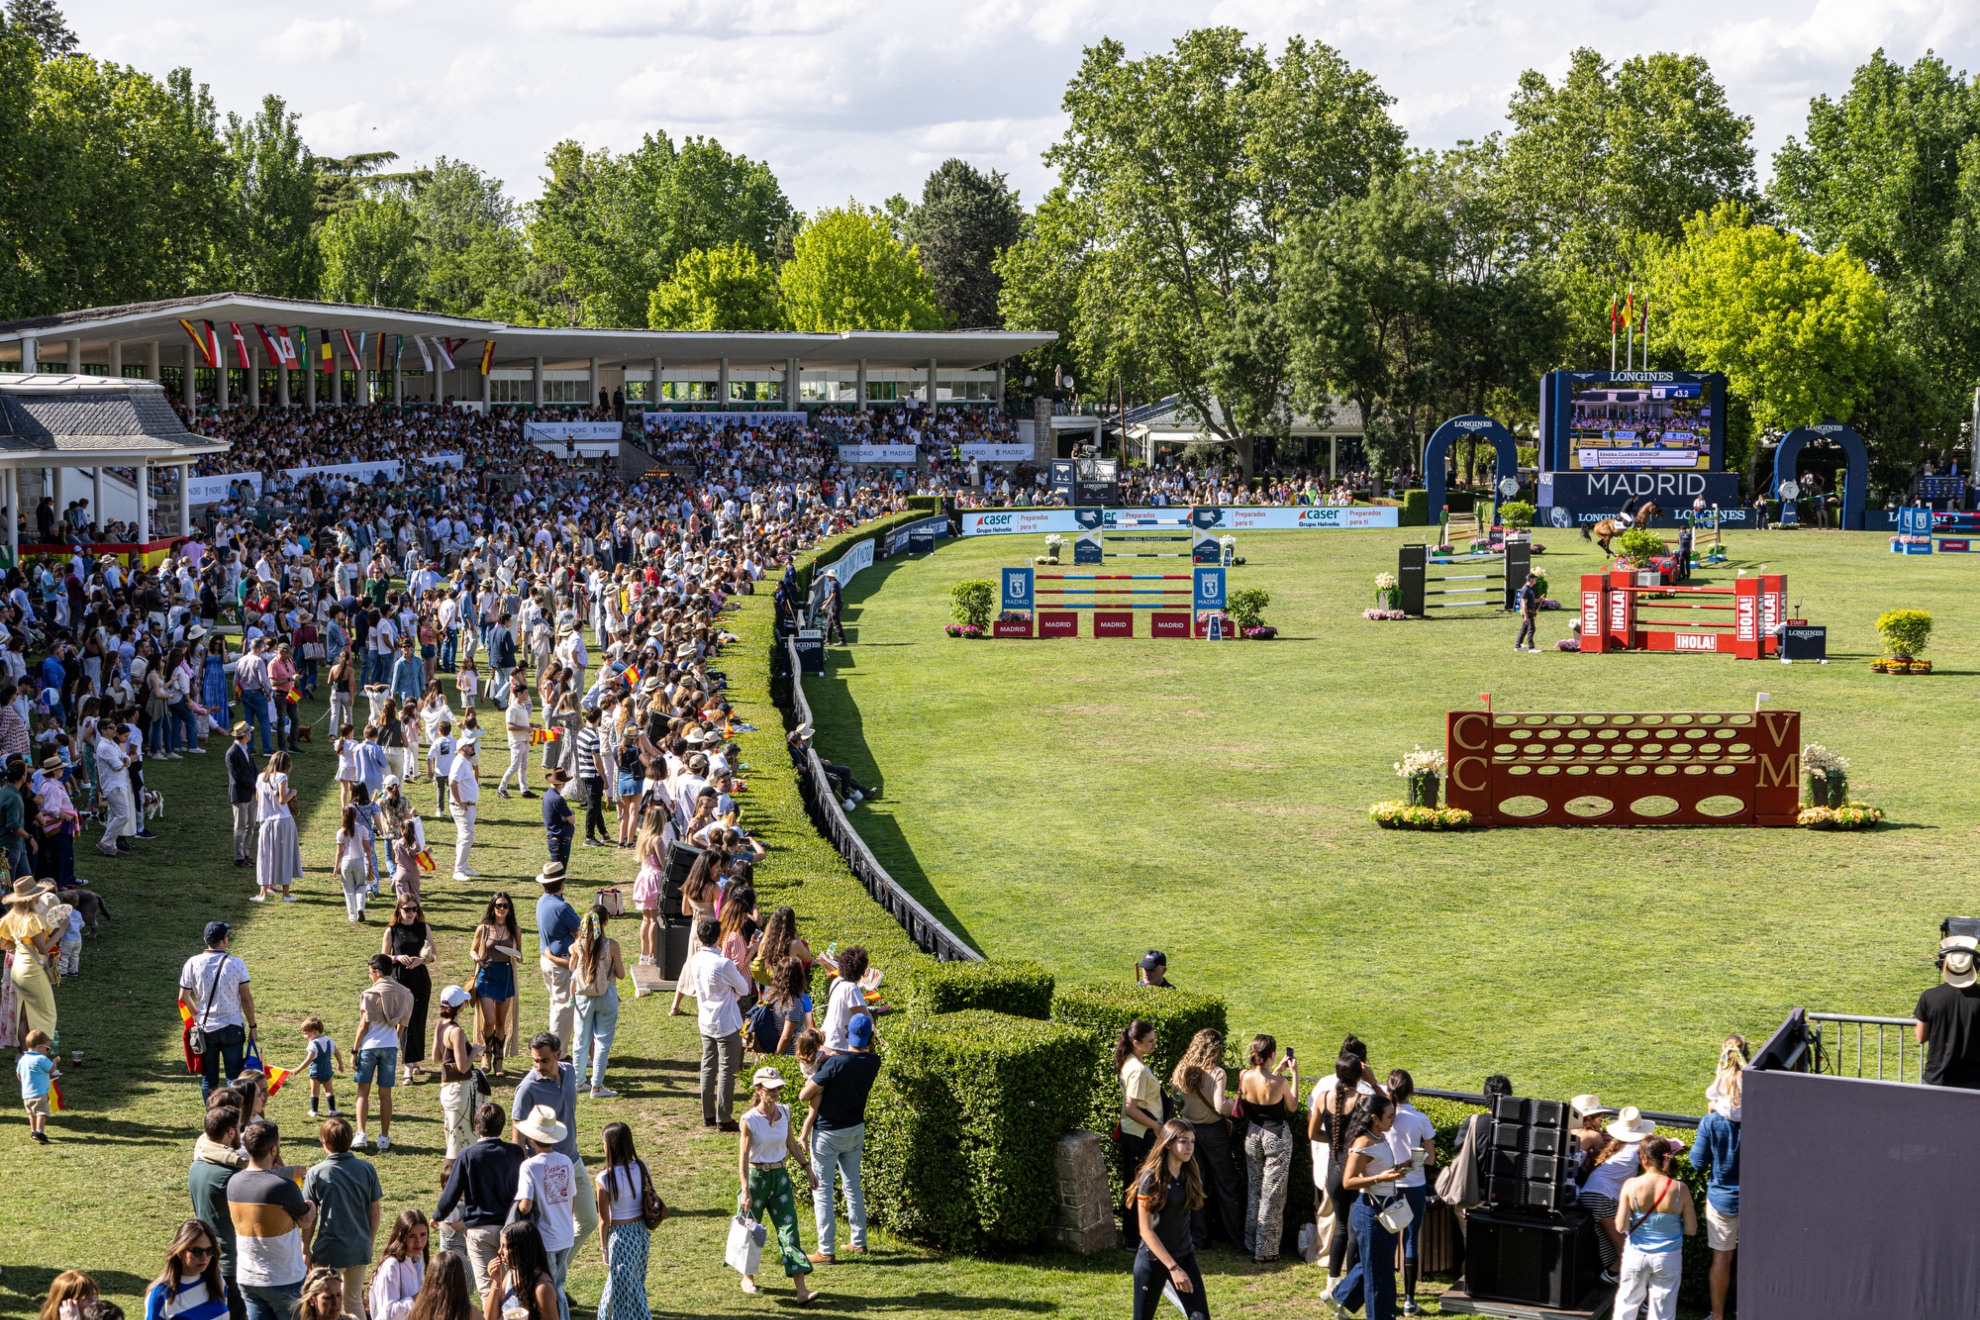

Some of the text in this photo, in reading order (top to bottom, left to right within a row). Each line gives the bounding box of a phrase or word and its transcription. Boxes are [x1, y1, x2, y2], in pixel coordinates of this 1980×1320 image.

[1610, 372, 1674, 382] LONGINES
[661, 415, 694, 424] MADRID
[762, 415, 798, 423] MADRID
[1587, 474, 1706, 496] MADRID
[984, 514, 1012, 525] caser
[1020, 514, 1048, 522] Preparados
[1307, 509, 1339, 519] caser
[1585, 593, 1597, 634] ¡HOLA!
[1739, 598, 1753, 639] ¡HOLA!
[1677, 635, 1715, 649] ¡HOLA!
[1453, 714, 1488, 750] C
[1760, 713, 1797, 747] V
[1453, 756, 1487, 791] C
[1756, 754, 1799, 787] M
